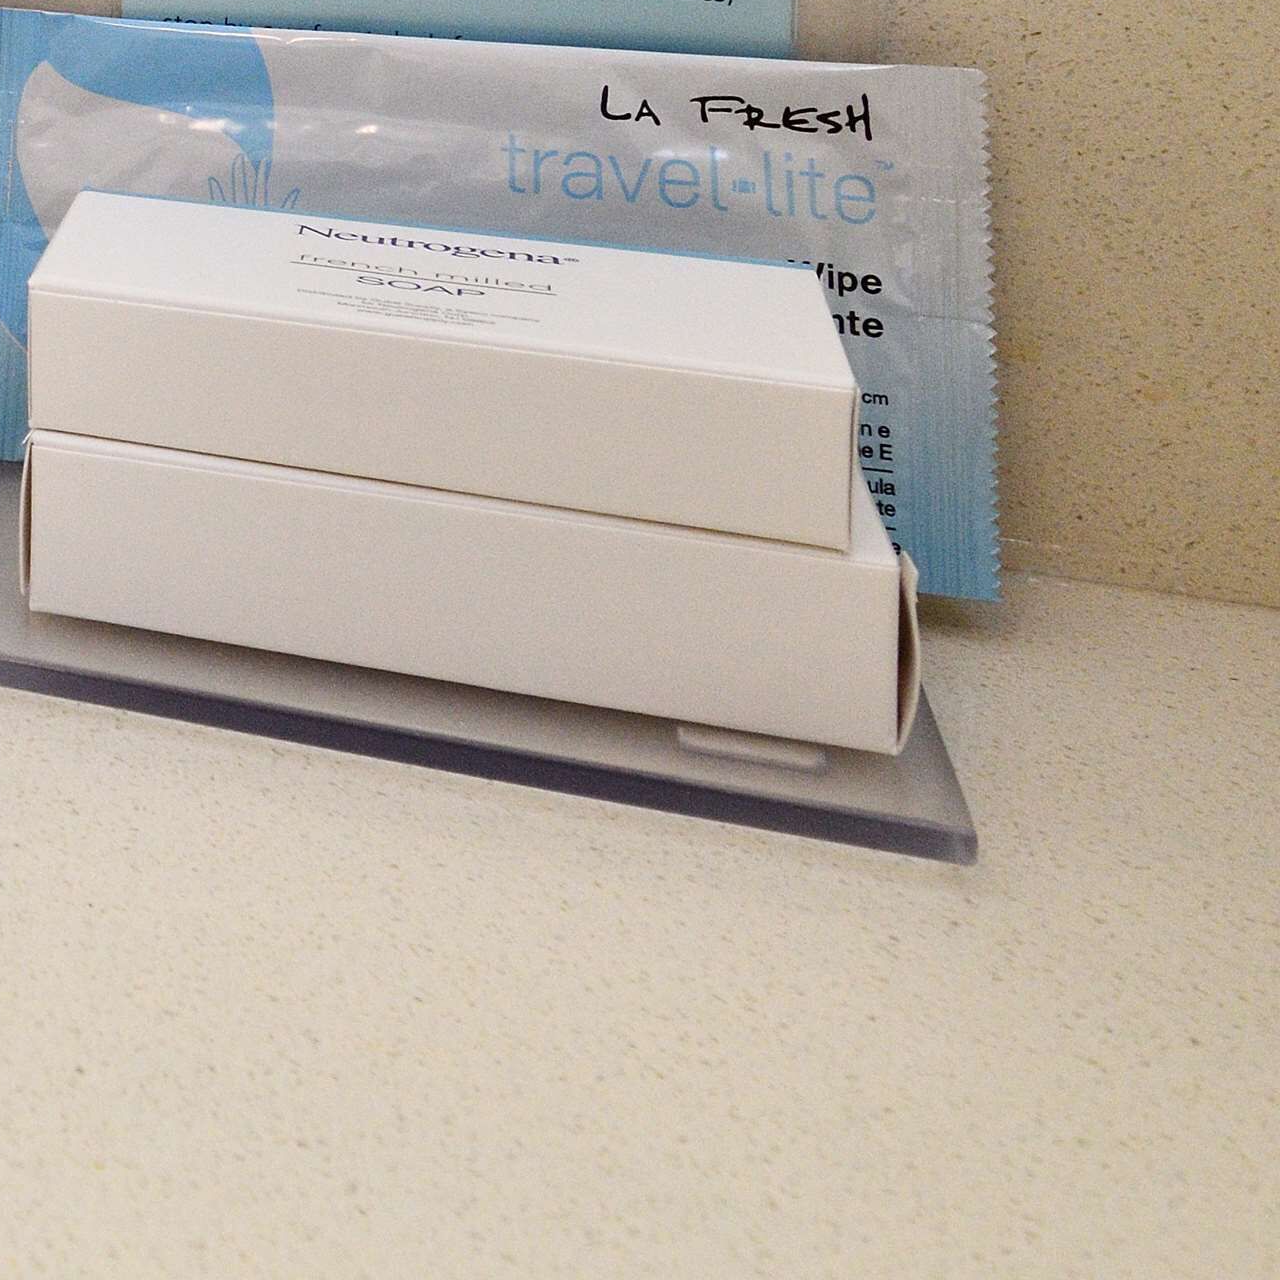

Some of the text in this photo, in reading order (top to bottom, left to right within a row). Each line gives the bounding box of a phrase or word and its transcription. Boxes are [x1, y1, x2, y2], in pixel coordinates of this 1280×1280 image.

[600, 84, 873, 142] LA FRESH
[299, 254, 553, 292] french milled
[354, 275, 486, 297] SOAP
